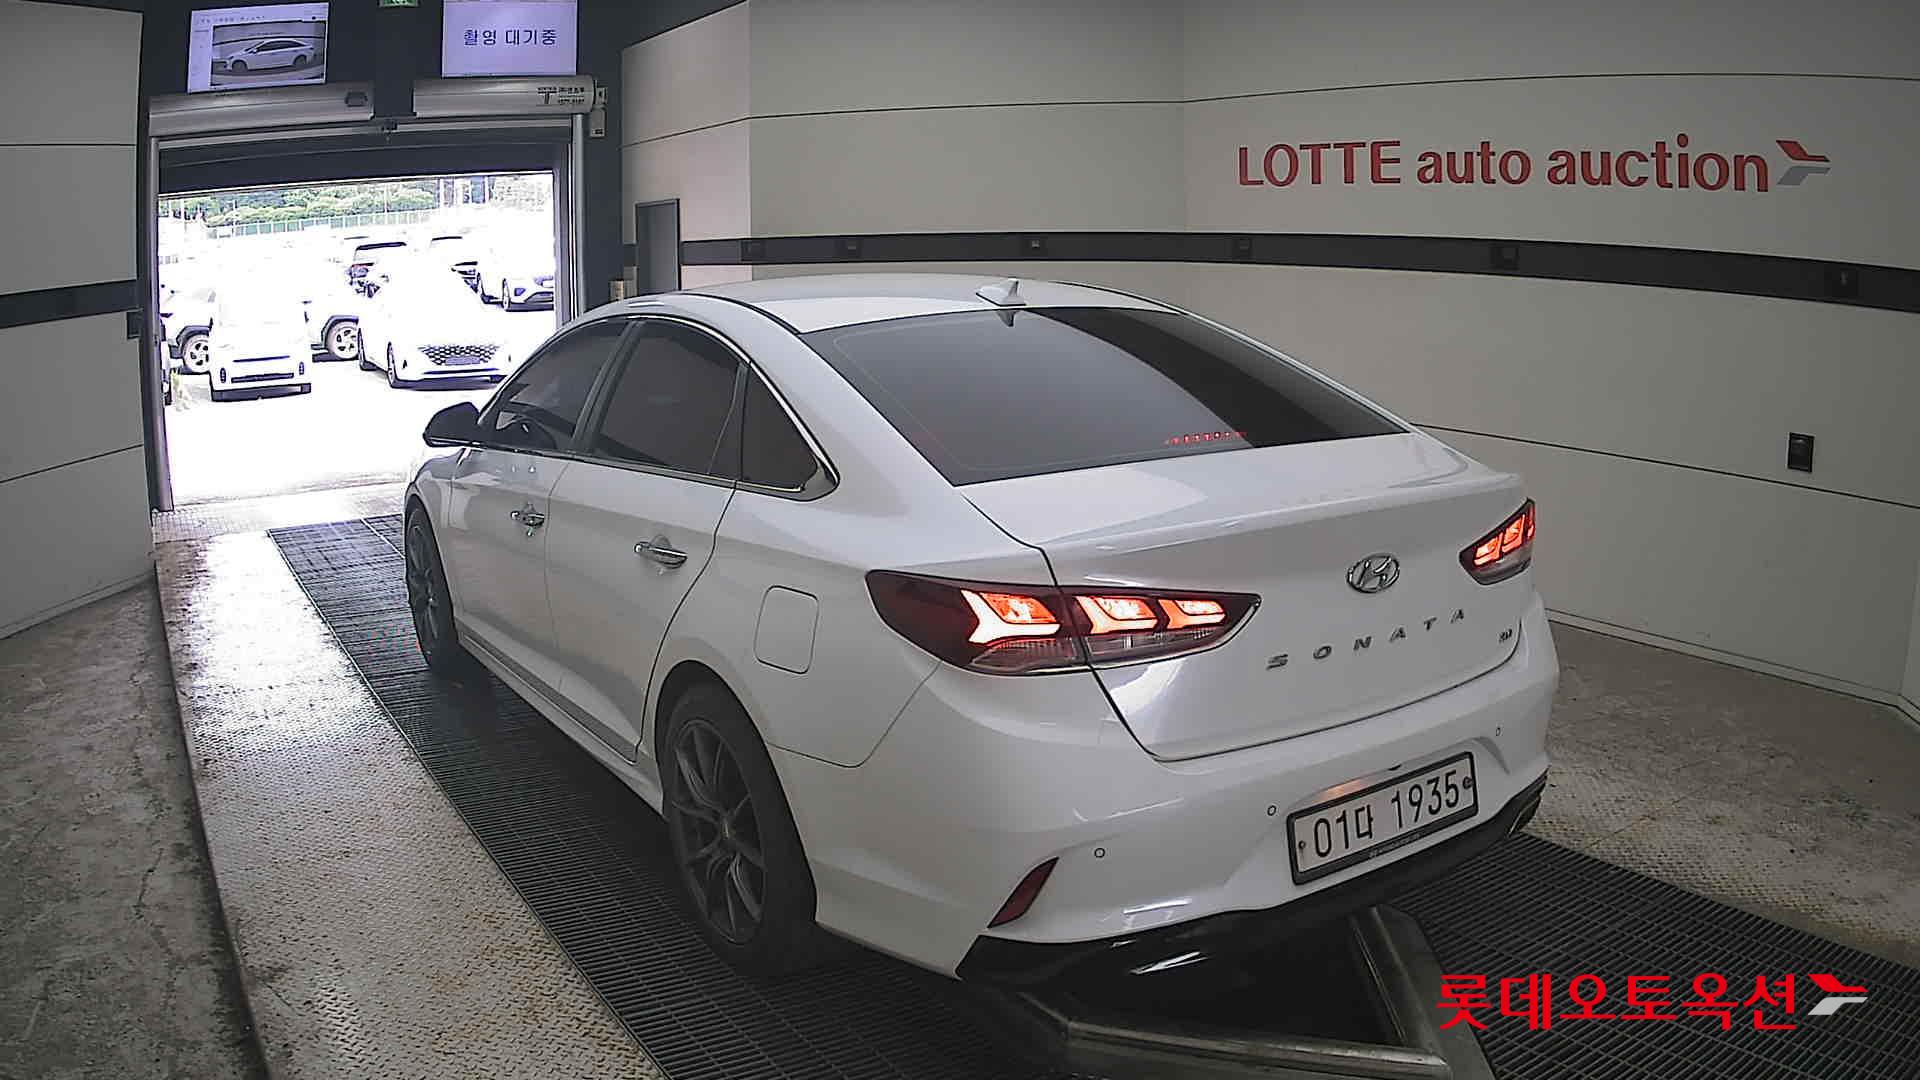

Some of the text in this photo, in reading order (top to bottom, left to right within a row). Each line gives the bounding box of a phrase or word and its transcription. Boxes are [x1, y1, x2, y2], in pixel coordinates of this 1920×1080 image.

[505, 29, 558, 46] 대기중
[1238, 134, 1770, 193] LOTTE auto auction
[1265, 608, 1466, 671] SONATA
[1313, 804, 1374, 858] 01다
[1391, 769, 1460, 830] 1935
